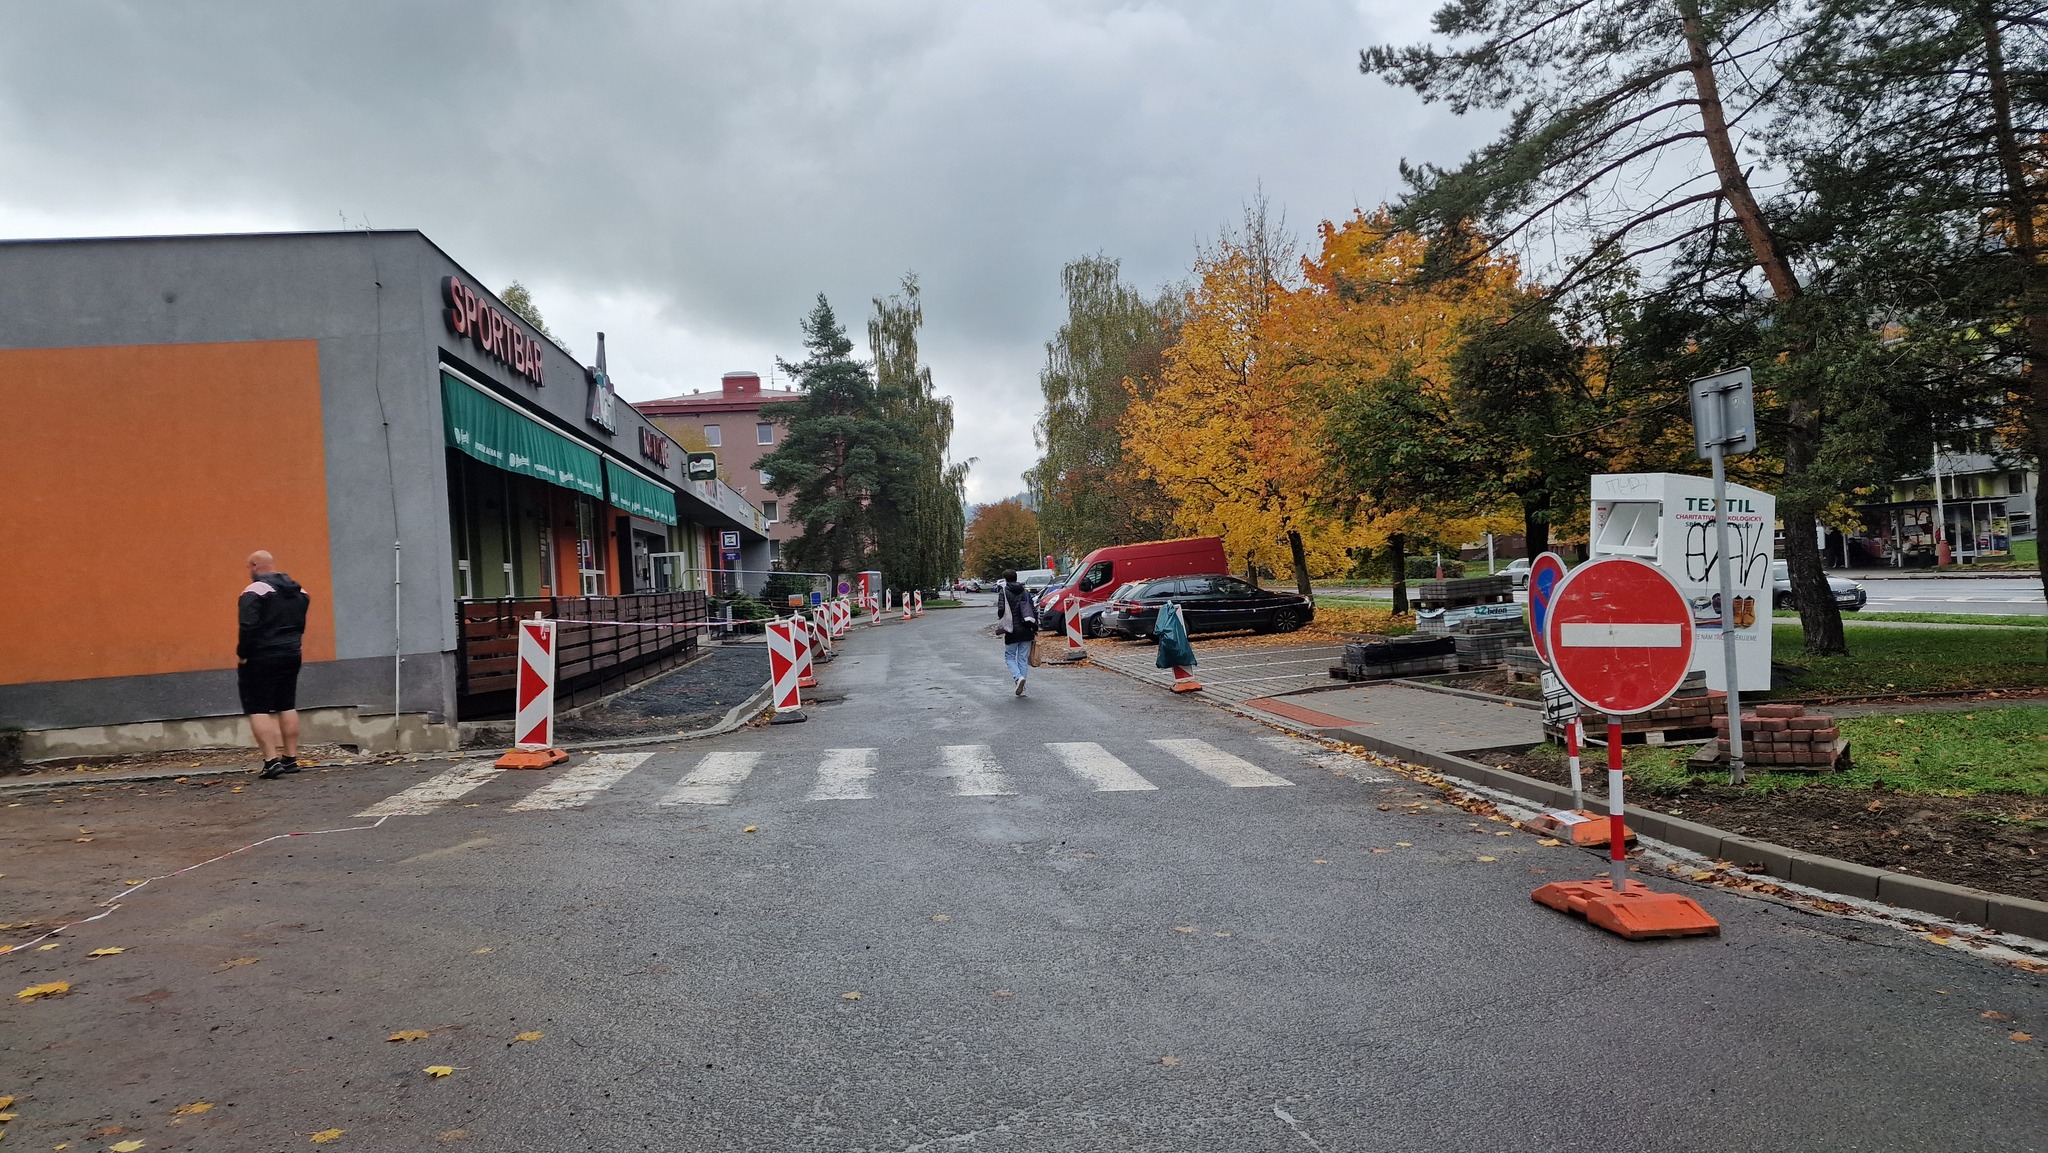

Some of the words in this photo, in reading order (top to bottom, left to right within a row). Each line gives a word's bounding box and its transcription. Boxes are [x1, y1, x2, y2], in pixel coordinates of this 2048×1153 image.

[449, 275, 545, 387] SPORTBAR
[1675, 513, 1717, 522] CHARITATIVN
[1727, 515, 1763, 523] KOLOGICKÝ
[1734, 633, 1757, 642] ĚKUJEME
